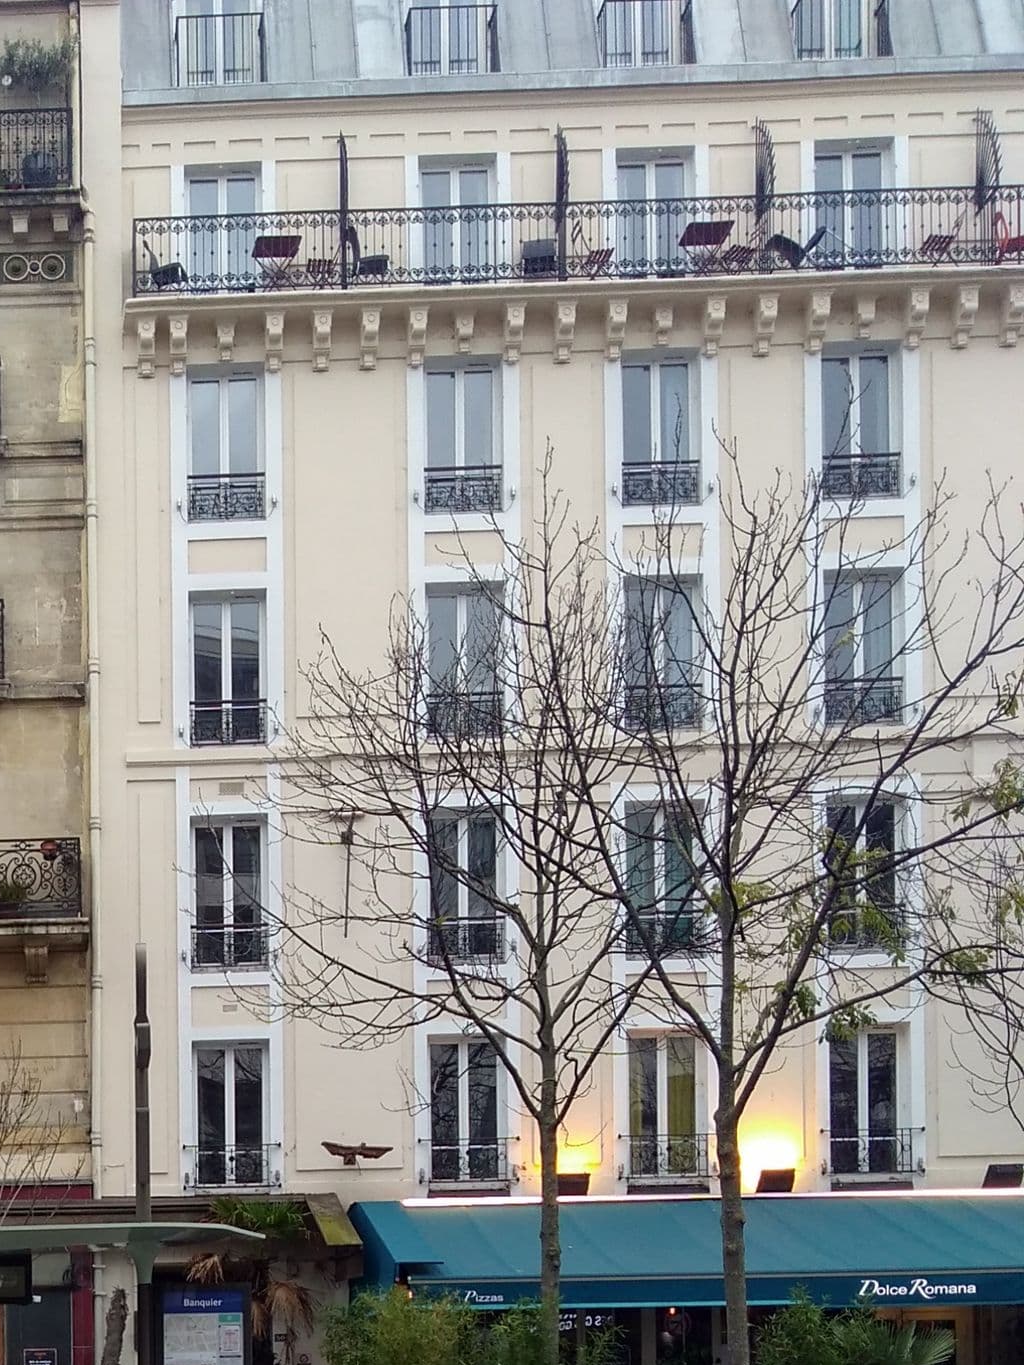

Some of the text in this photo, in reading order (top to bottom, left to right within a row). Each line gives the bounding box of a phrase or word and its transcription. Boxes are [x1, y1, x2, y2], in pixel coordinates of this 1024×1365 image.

[464, 1289, 504, 1303] Pizzas
[858, 1278, 977, 1300] Dolce Romana
[183, 1298, 223, 1309] Banquier
